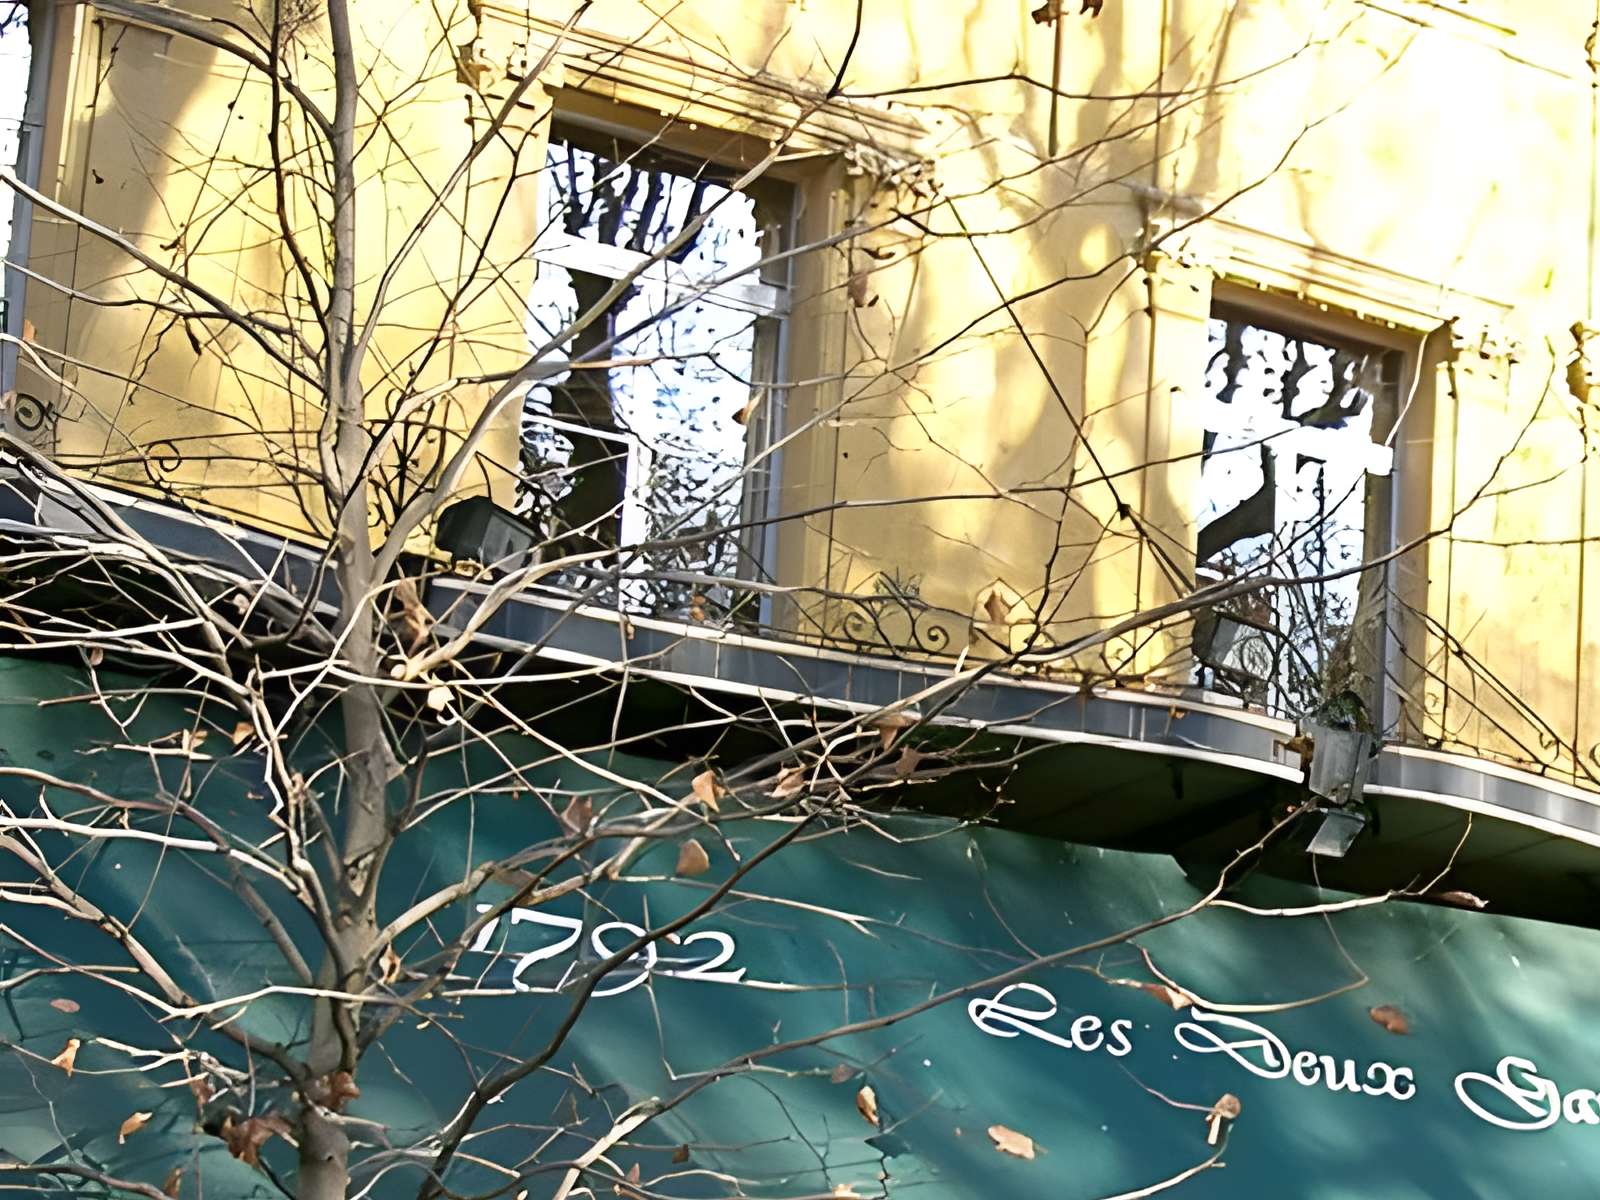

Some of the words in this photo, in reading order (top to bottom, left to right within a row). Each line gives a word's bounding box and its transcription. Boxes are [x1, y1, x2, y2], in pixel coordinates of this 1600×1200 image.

[467, 903, 746, 998] 1792
[968, 982, 1133, 1056] Les
[1174, 1006, 1416, 1100] Deux
